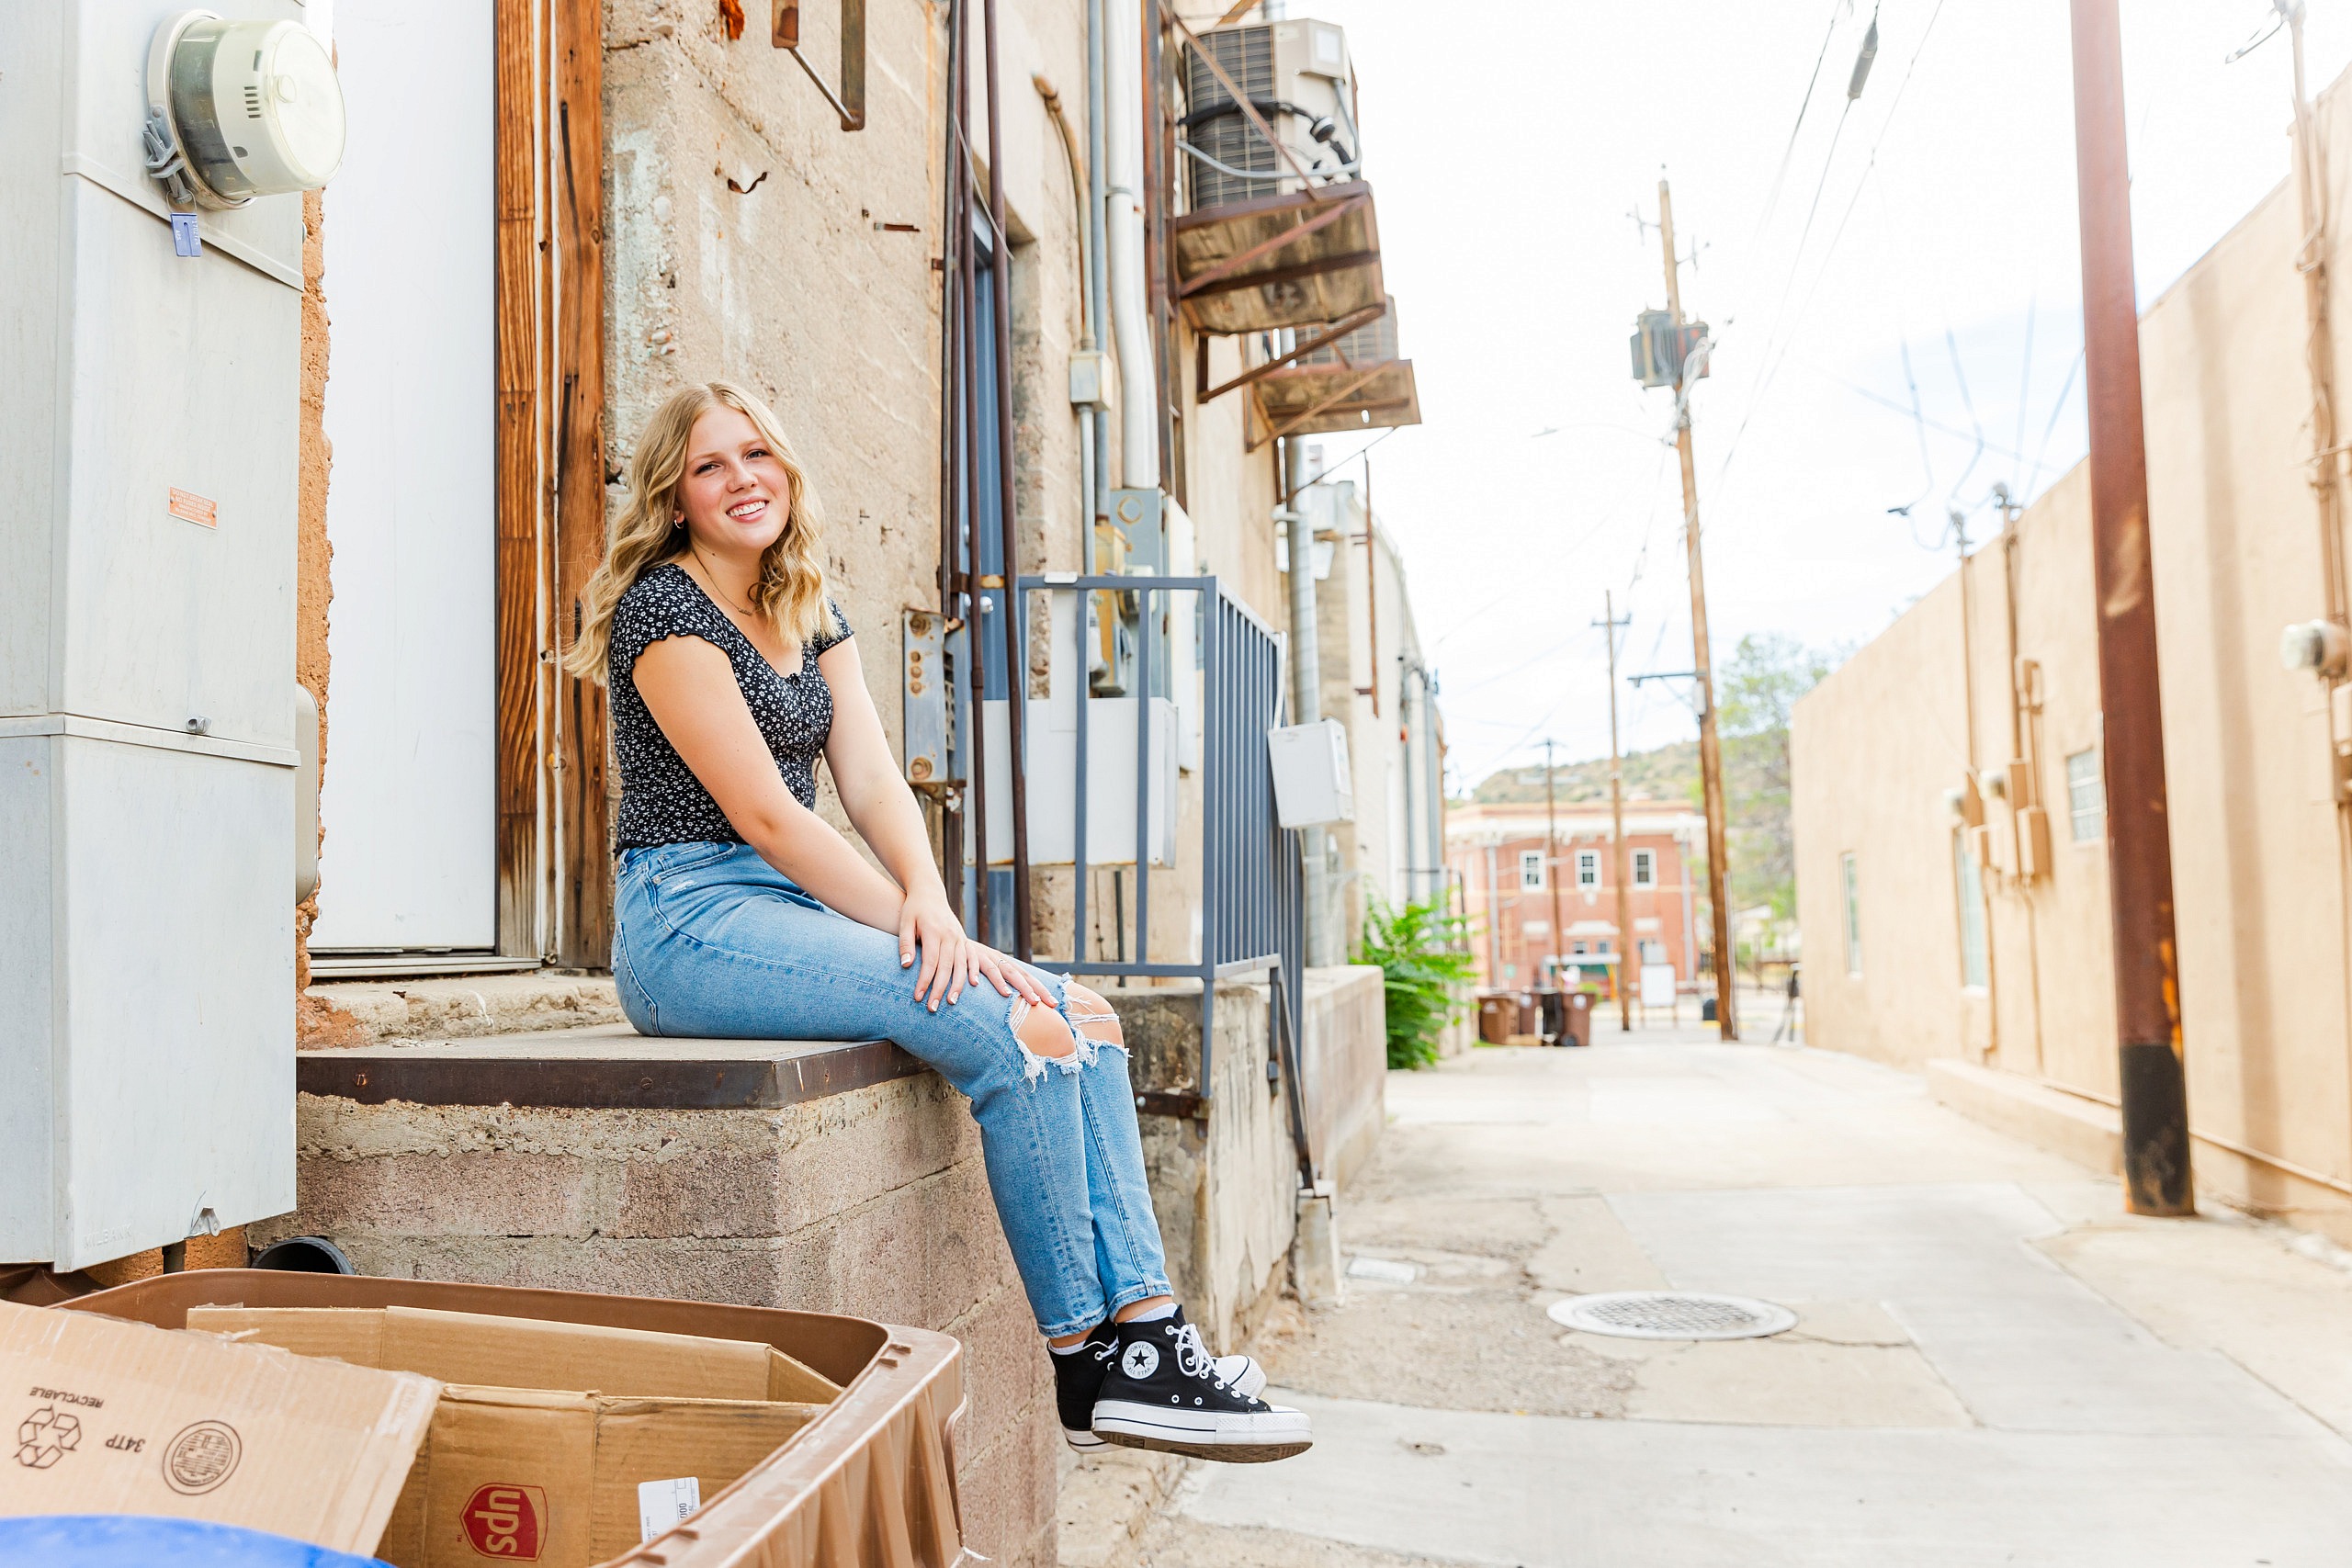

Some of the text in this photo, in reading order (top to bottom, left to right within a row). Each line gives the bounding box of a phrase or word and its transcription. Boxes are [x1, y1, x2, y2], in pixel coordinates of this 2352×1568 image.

[85, 1224, 132, 1249] MILBANK
[1127, 1344, 1155, 1356] CONVERSE
[1127, 1367, 1152, 1376] ALL STAR
[29, 1387, 104, 1408] RECYCLABLE
[105, 1434, 145, 1453] 34TP
[678, 1503, 687, 1520] 000
[474, 1490, 521, 1553] ups
